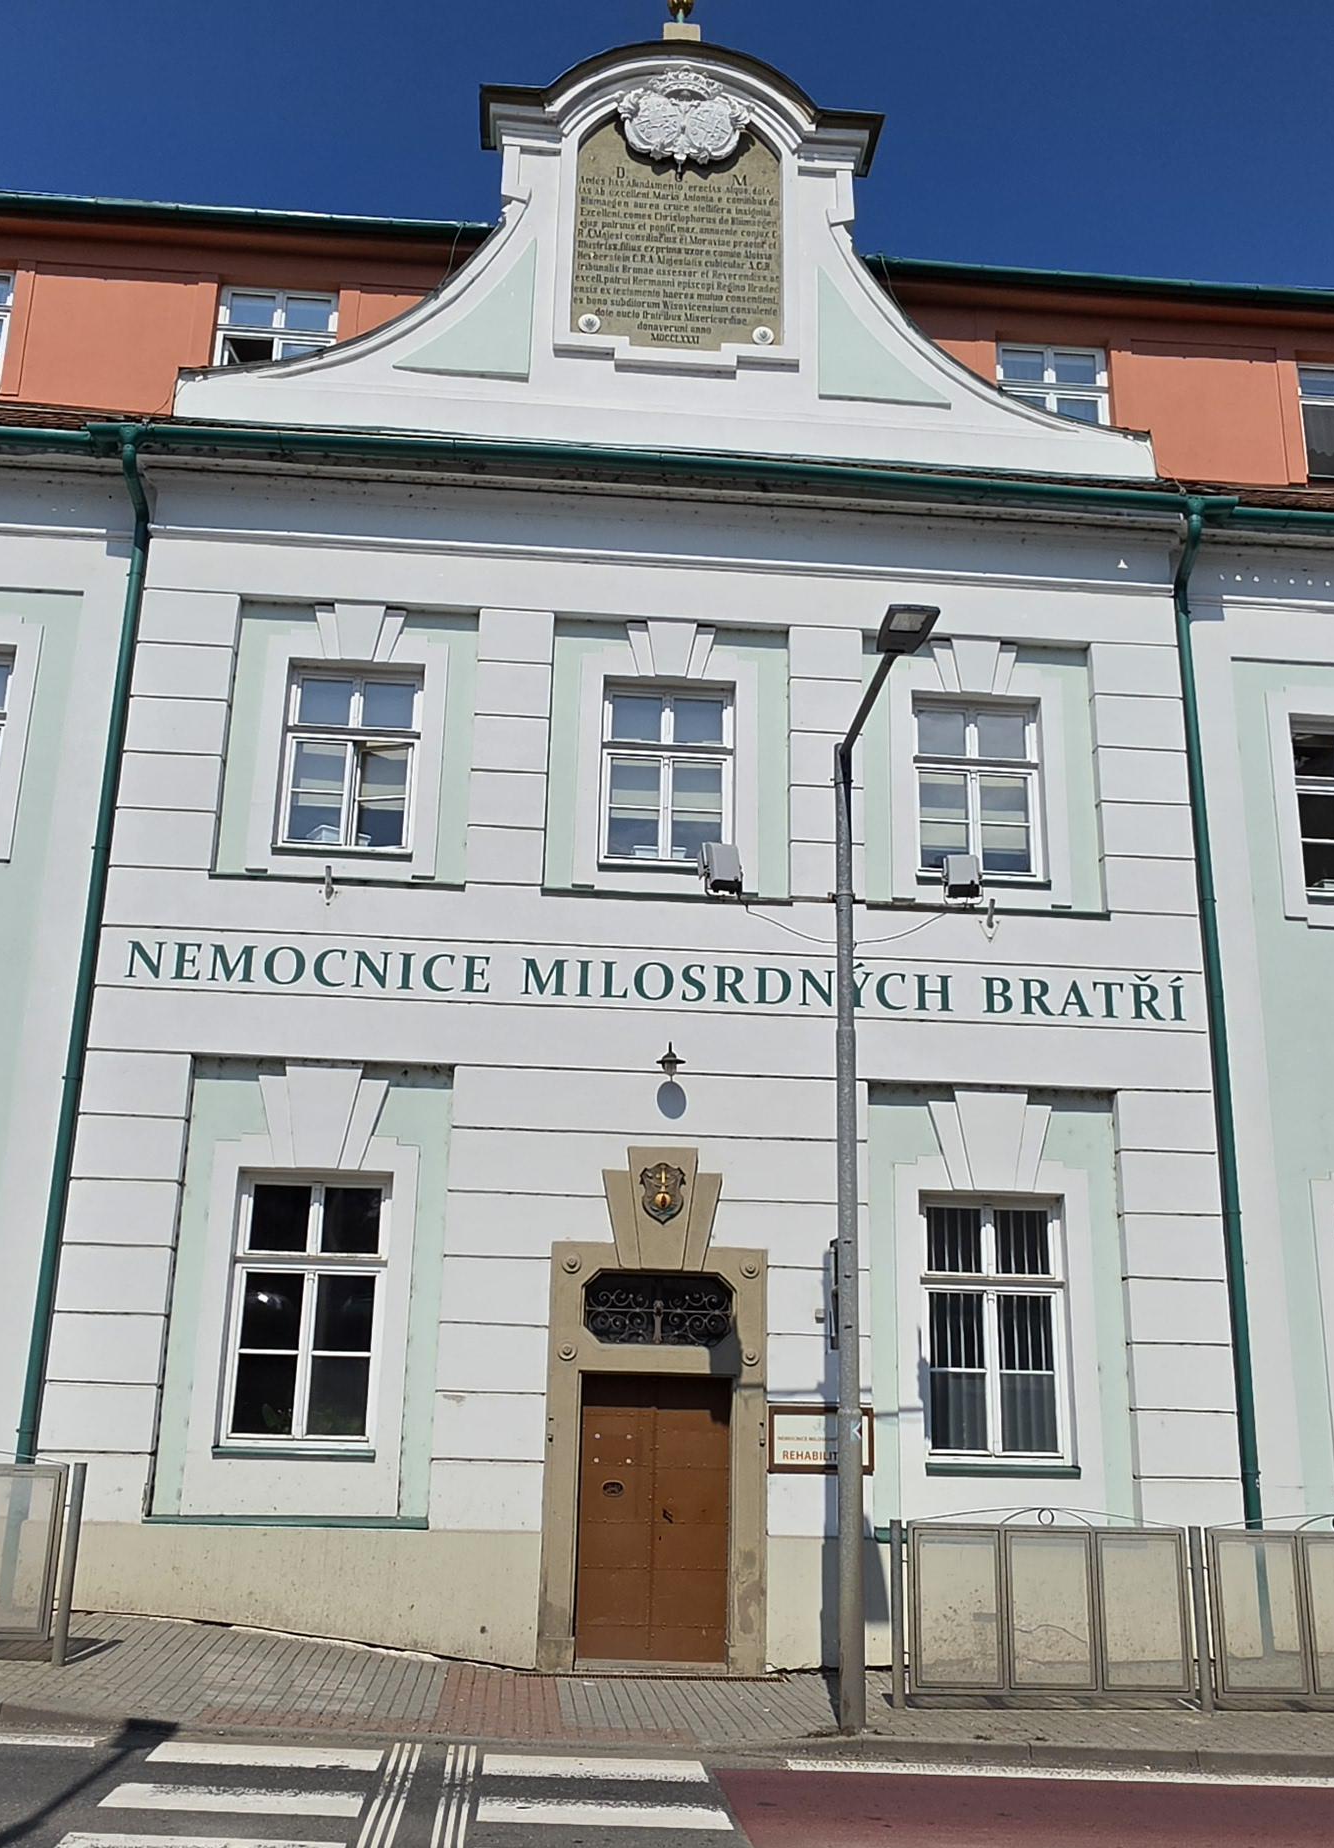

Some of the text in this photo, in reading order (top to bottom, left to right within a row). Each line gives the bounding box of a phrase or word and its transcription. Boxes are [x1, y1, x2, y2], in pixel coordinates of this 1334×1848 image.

[124, 940, 1187, 1021] NEMOCNICE MILOSRDNÝCH BRATŘÍ
